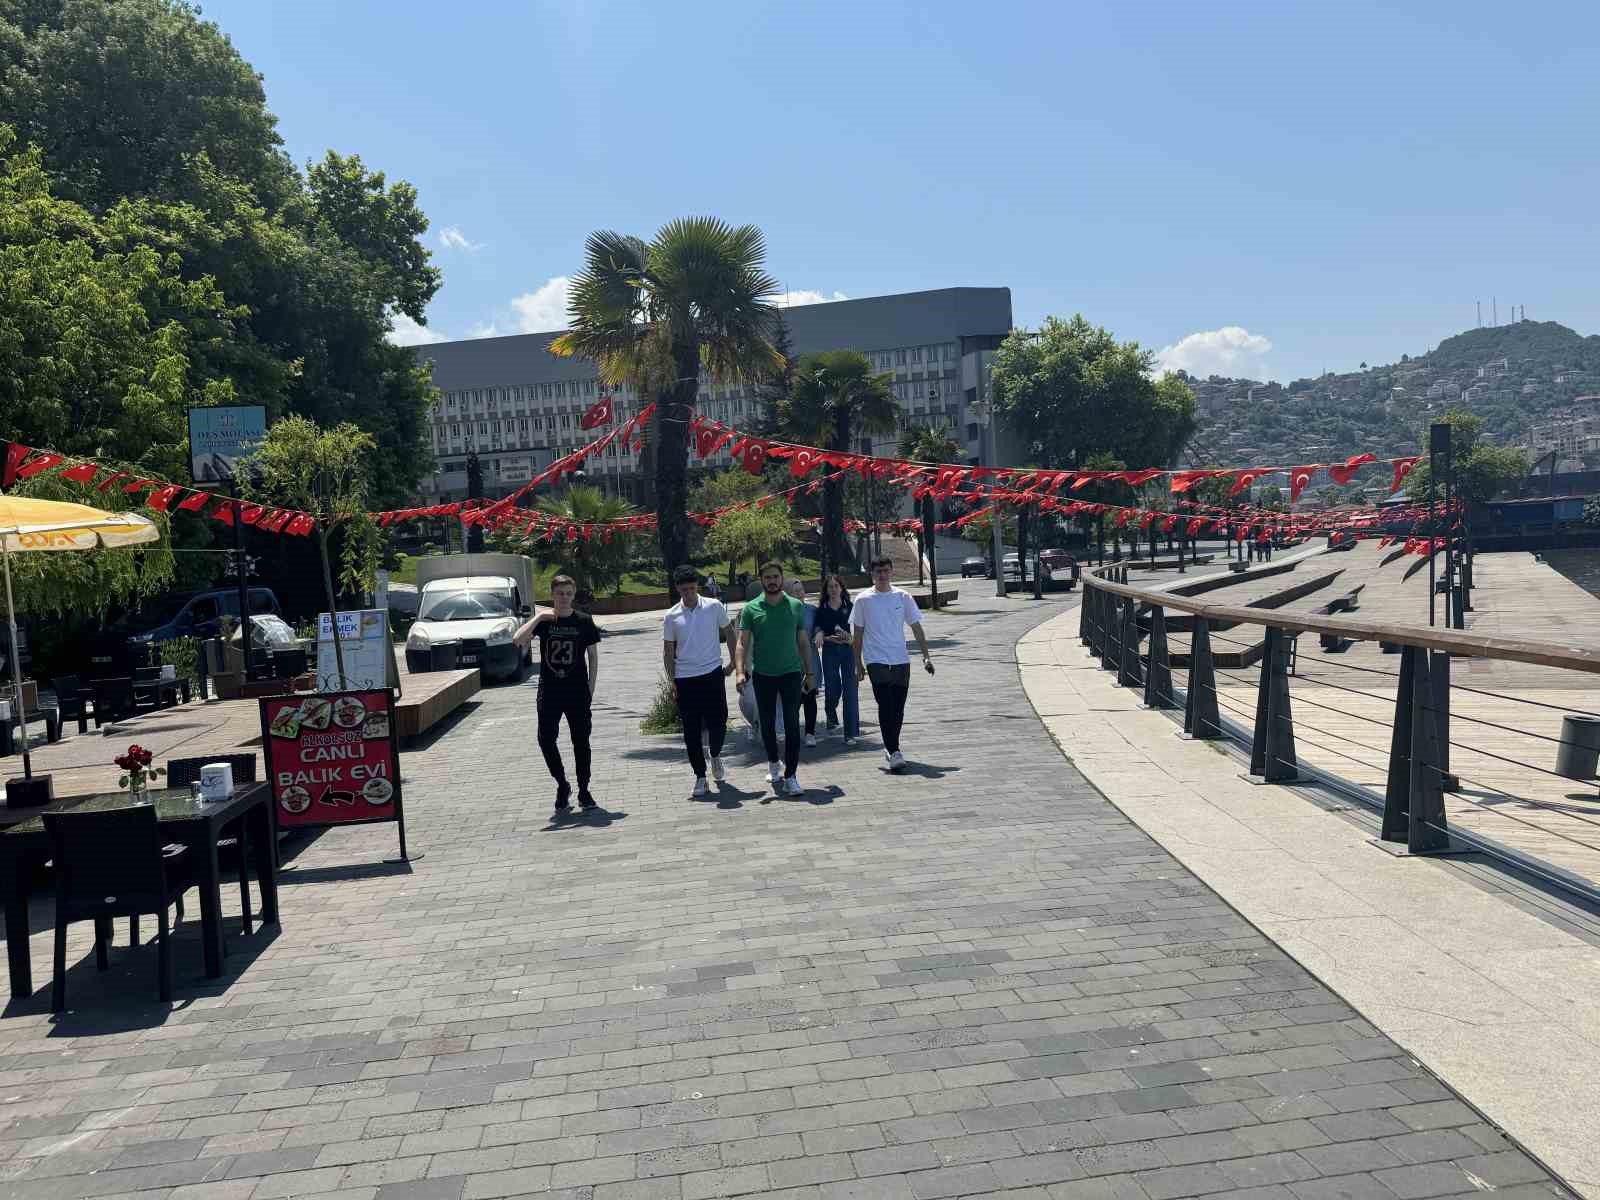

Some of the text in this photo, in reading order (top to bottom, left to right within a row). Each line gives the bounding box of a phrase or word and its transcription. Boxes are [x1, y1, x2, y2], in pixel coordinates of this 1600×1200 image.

[323, 614, 352, 624] BLIK
[322, 624, 358, 634] EMEK
[551, 640, 574, 665] 23
[300, 744, 365, 763] CANLI
[278, 760, 386, 785] BALIK EVİ
